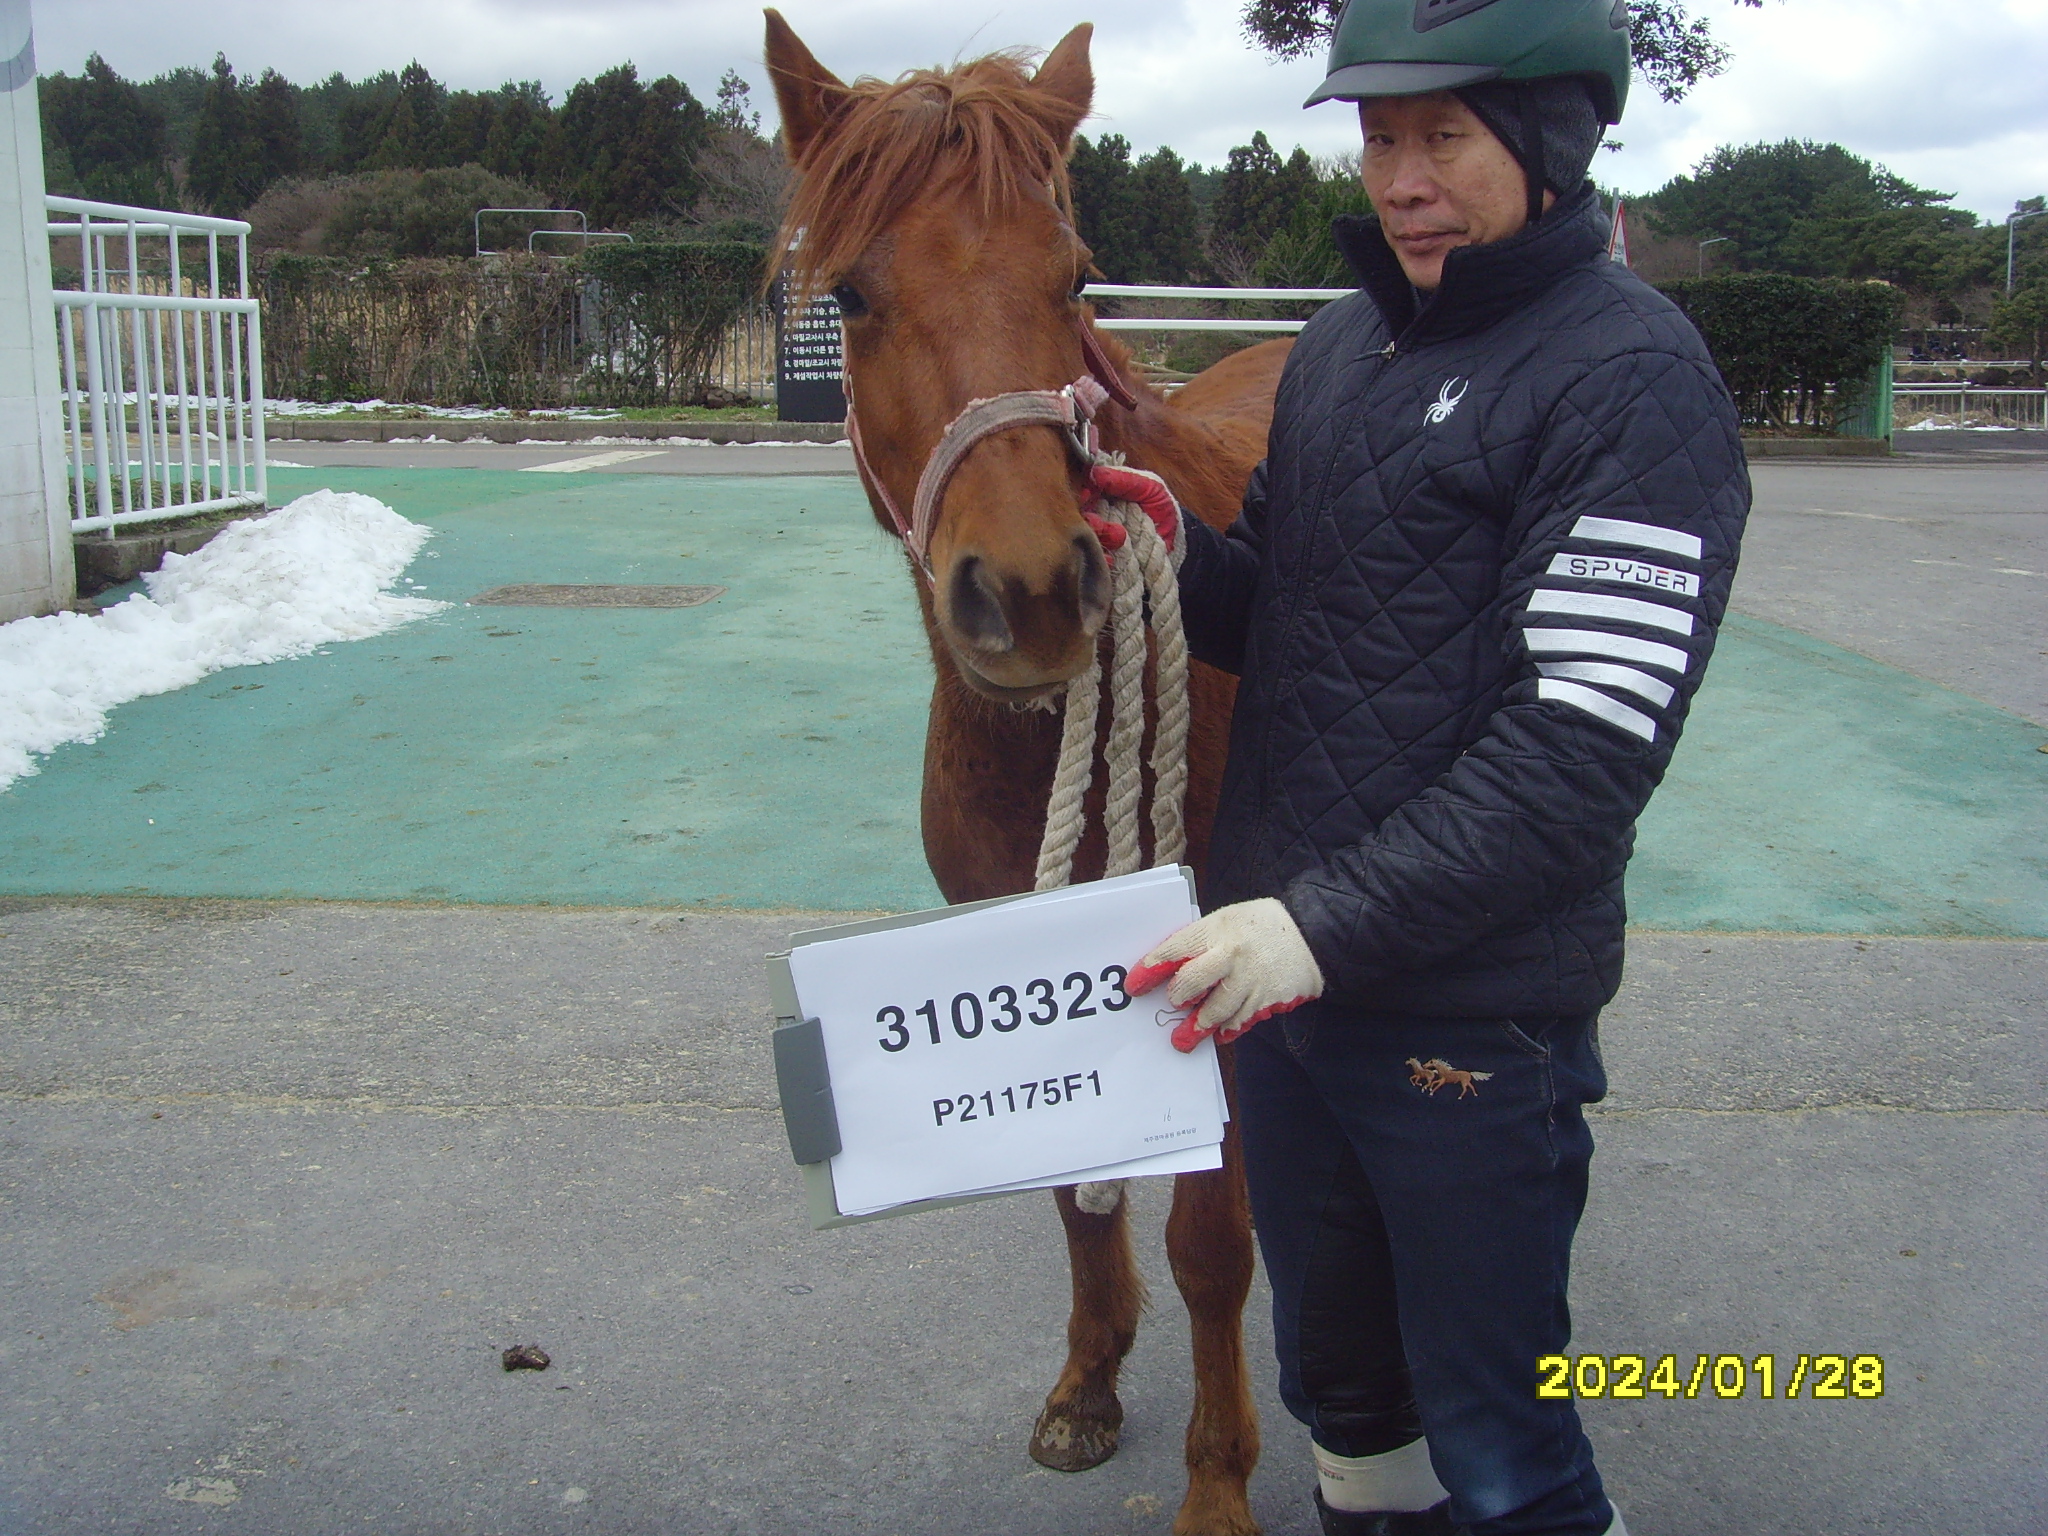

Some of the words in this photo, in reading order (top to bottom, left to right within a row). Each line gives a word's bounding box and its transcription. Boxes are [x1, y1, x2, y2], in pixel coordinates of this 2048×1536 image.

[784, 334, 791, 342] 6.
[784, 347, 791, 355] 7.
[792, 346, 812, 355] 이동시
[813, 345, 827, 355] 다른
[784, 359, 792, 368] 8.
[784, 372, 792, 381] 9.
[1569, 558, 1688, 593] SPYDER
[875, 963, 1134, 1053] 3103323
[932, 1069, 1103, 1127] P21175F1
